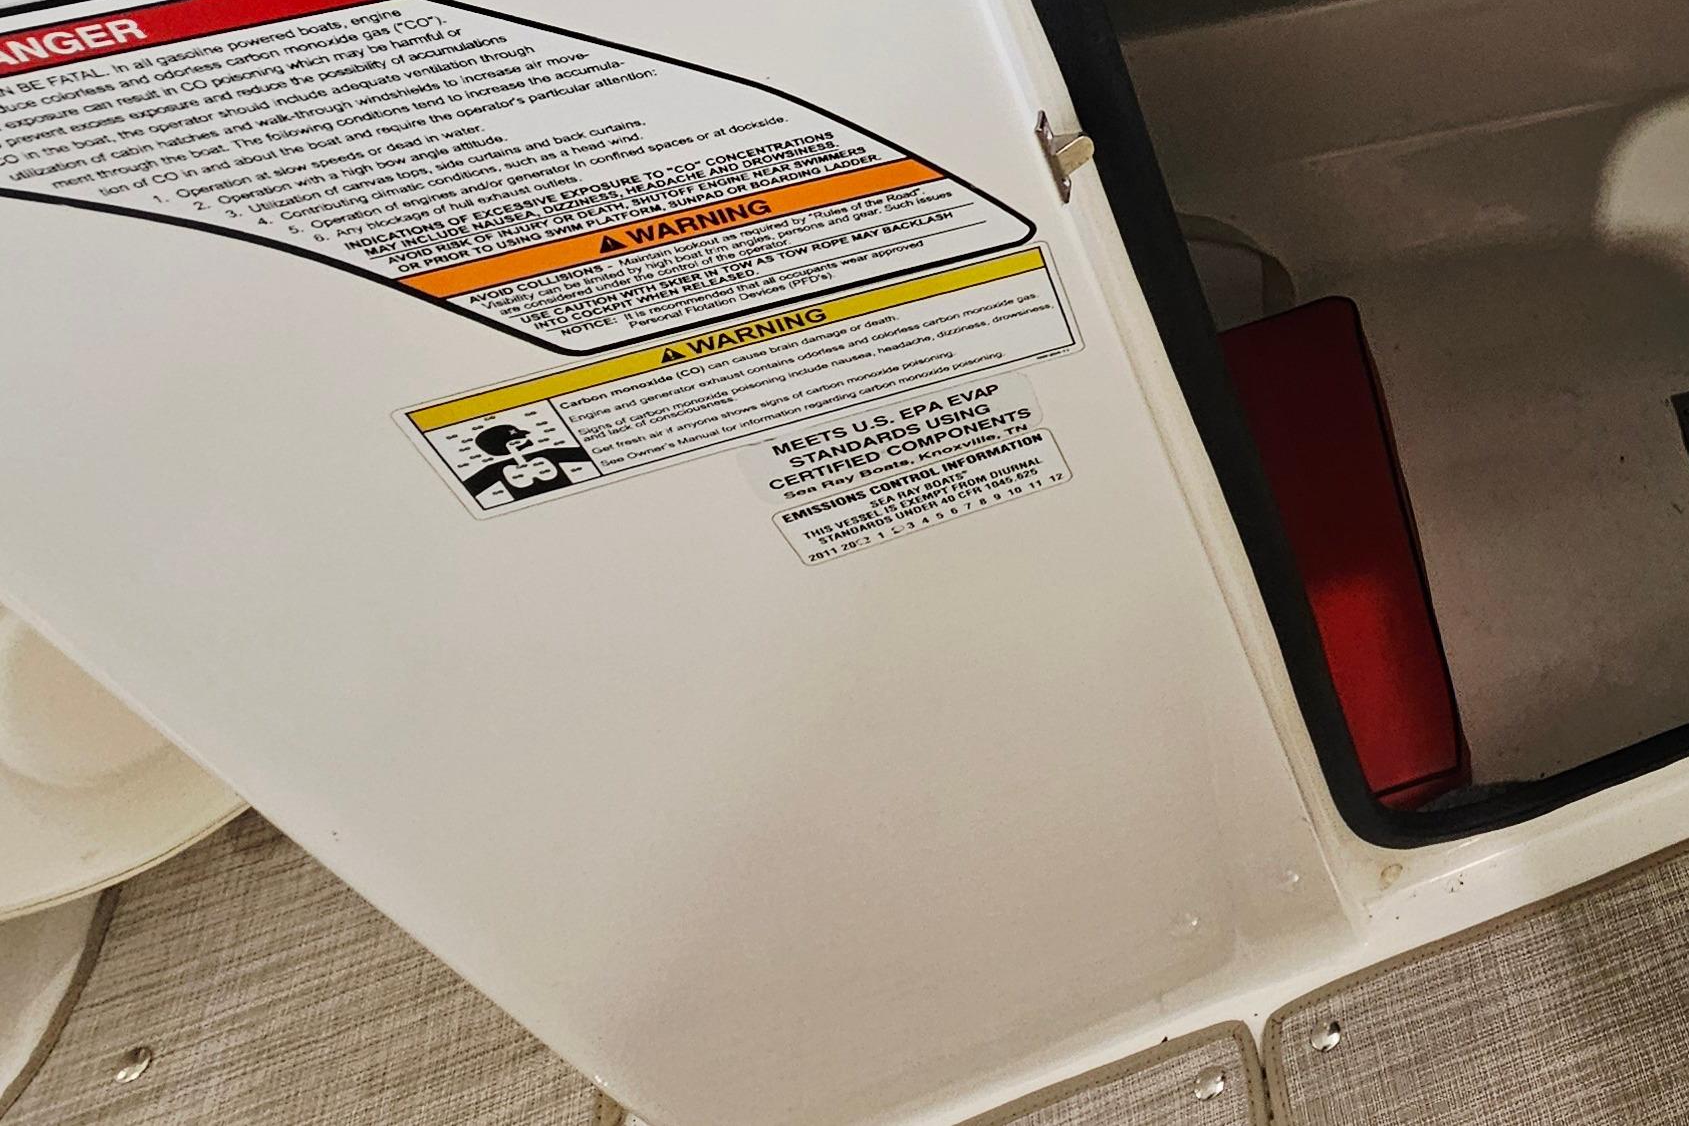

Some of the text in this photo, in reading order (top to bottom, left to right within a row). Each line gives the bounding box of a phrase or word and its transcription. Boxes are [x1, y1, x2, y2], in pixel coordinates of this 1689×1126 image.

[624, 199, 772, 245] WARNING
[687, 309, 828, 354] WARNING
[768, 407, 1032, 490] CERTIFIED COMPONENTS
[771, 383, 999, 457] MEETS U.S. EPA EVAP
[788, 403, 991, 469] STANDARDS USING
[781, 432, 1044, 524] EMISSIONS CONTROL INFORMATION
